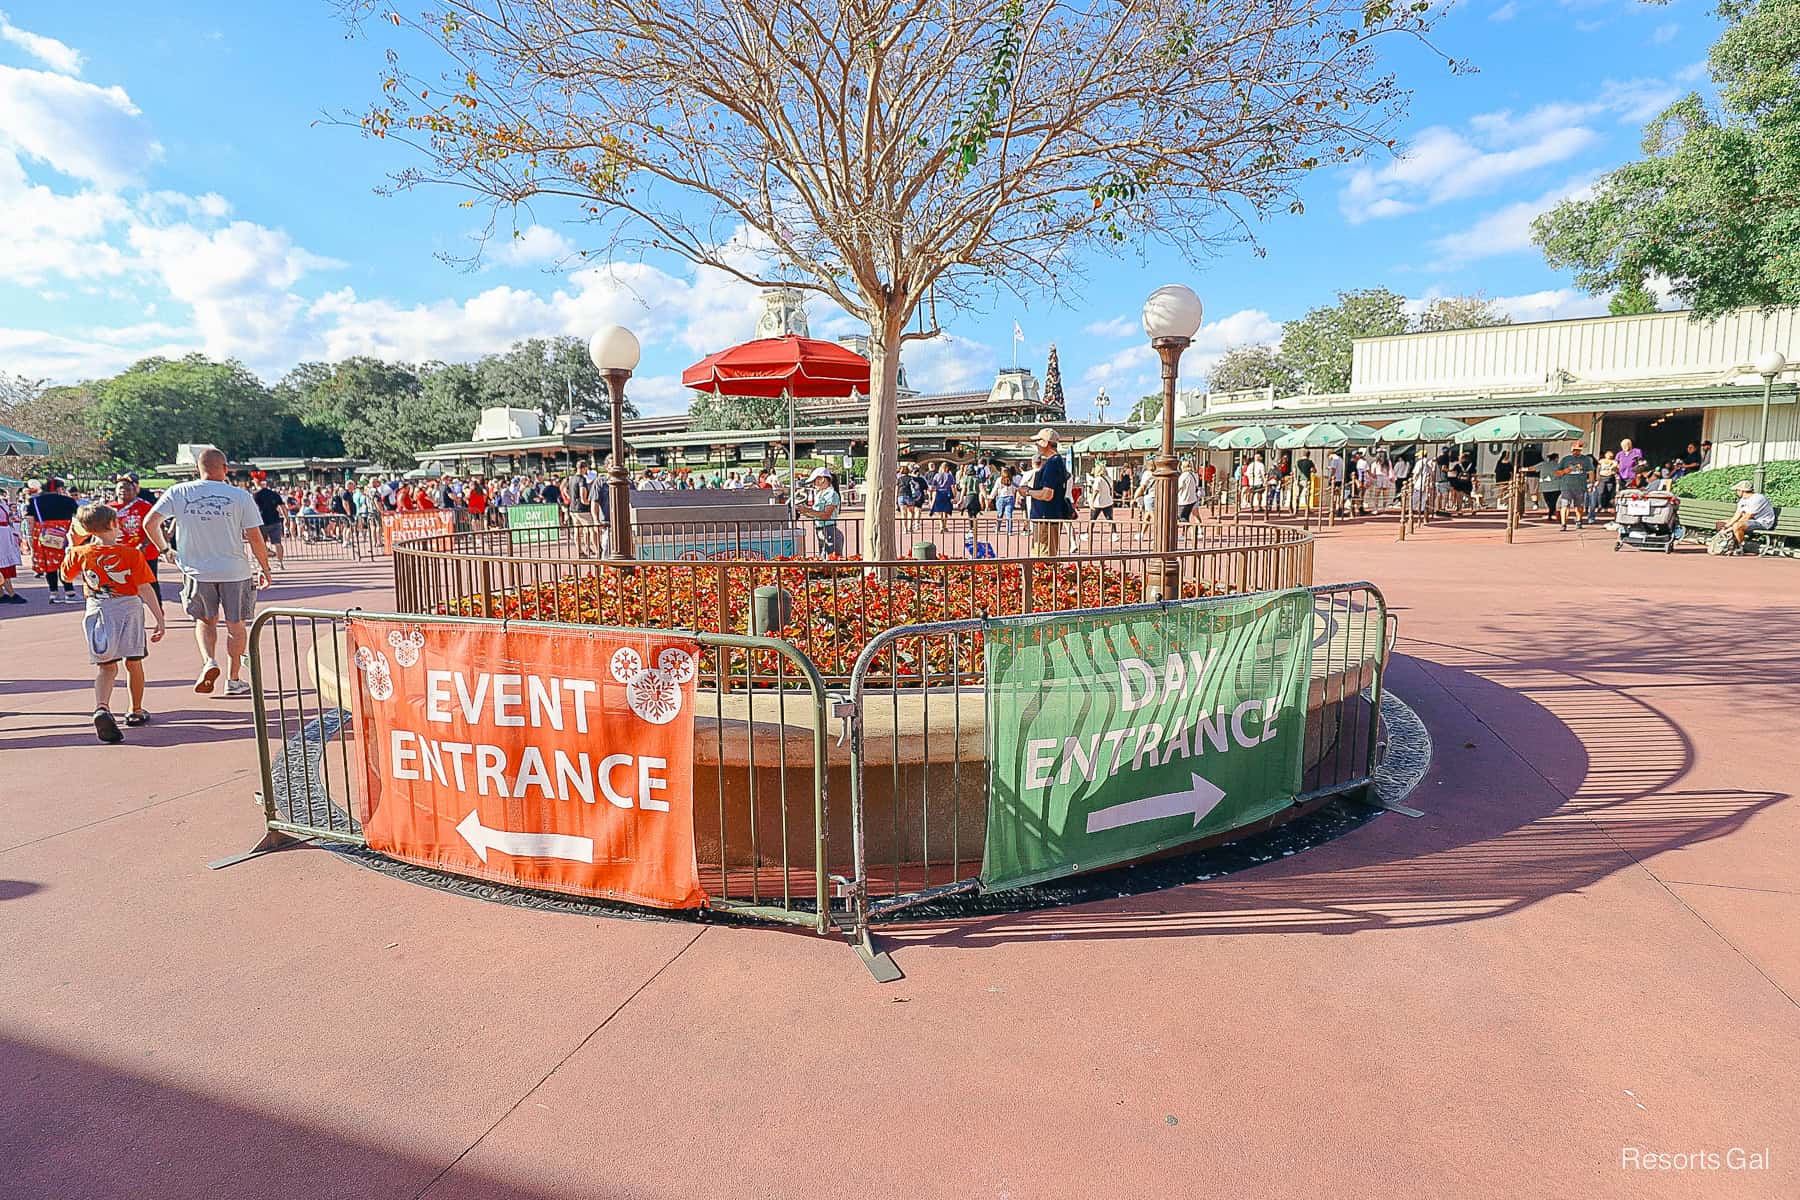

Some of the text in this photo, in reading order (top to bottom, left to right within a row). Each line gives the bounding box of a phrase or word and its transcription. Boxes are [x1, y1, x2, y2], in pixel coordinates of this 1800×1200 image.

[392, 527, 449, 541] ENTRANCE
[402, 516, 436, 529] EVENT
[526, 511, 542, 520] DAY
[426, 670, 596, 734] EVENT
[1119, 648, 1219, 712] DAY
[391, 730, 670, 812] ENTRANCE
[1025, 695, 1282, 790] ENTRANCE
